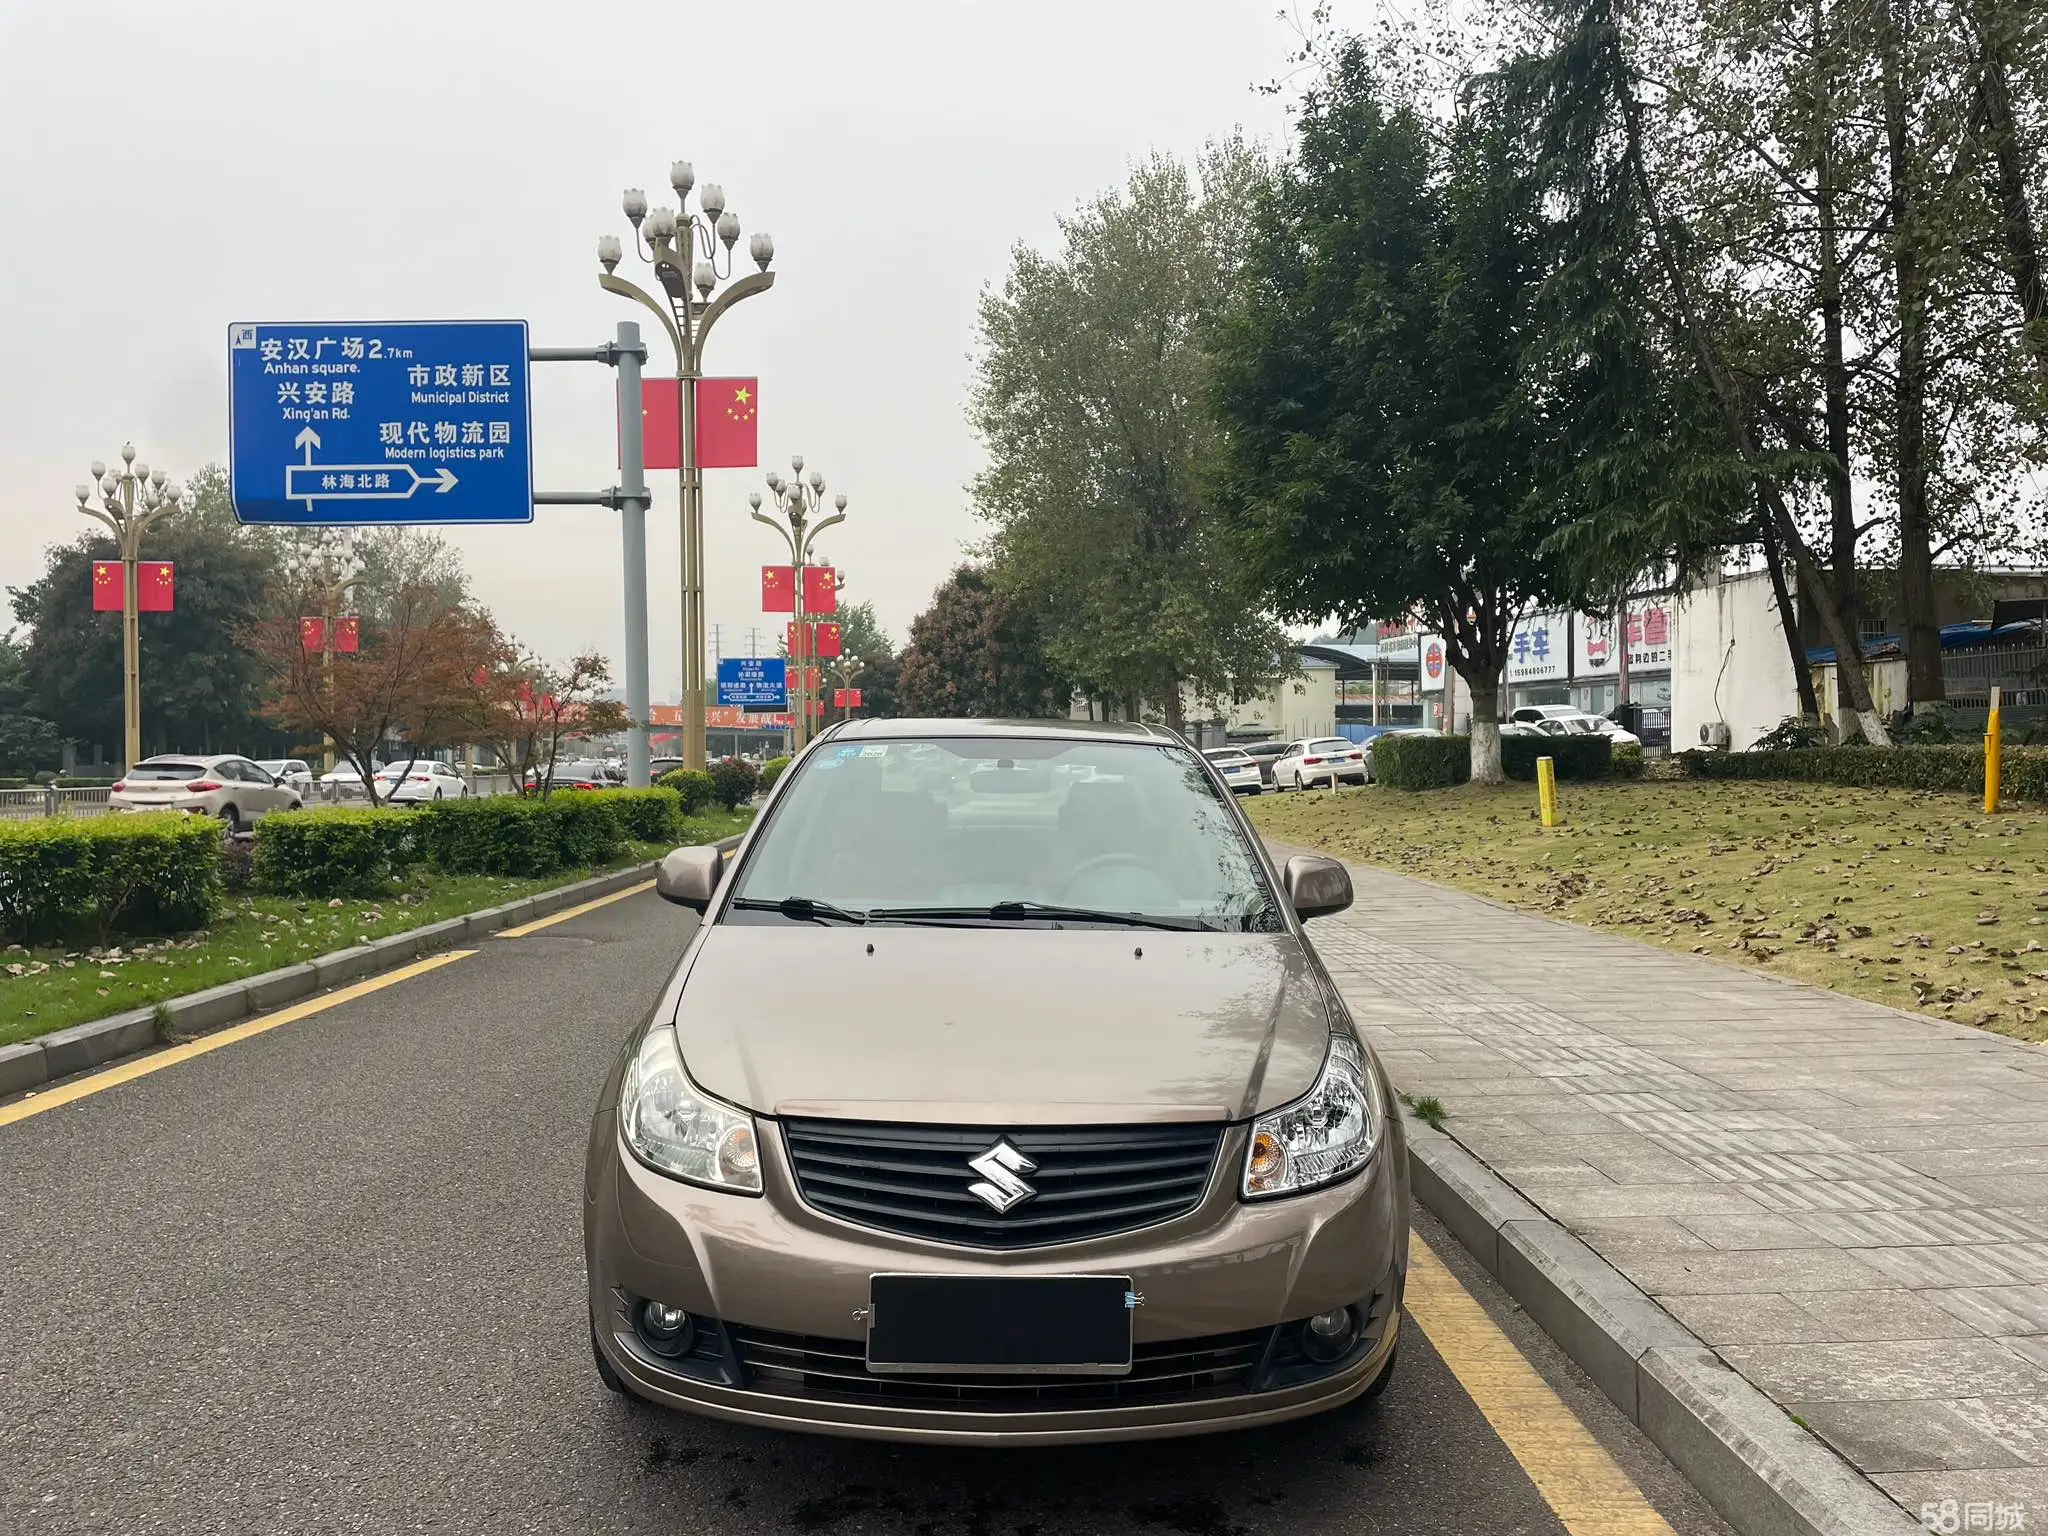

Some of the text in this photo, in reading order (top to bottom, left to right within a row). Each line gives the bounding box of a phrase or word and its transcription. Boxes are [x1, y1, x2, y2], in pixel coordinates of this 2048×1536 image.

[242, 329, 253, 340] 西
[260, 337, 364, 361] 安汉广场
[264, 363, 308, 374] Anhan
[407, 364, 511, 387] 市政新区
[277, 381, 355, 404] 兴安路
[411, 391, 509, 405] Municipal District
[282, 408, 350, 422] Xing'an Rd.
[379, 421, 510, 444] 现代物流园
[385, 447, 504, 461] Modern logistics park
[321, 474, 390, 489] 林海北路
[1508, 626, 1550, 664] 手车
